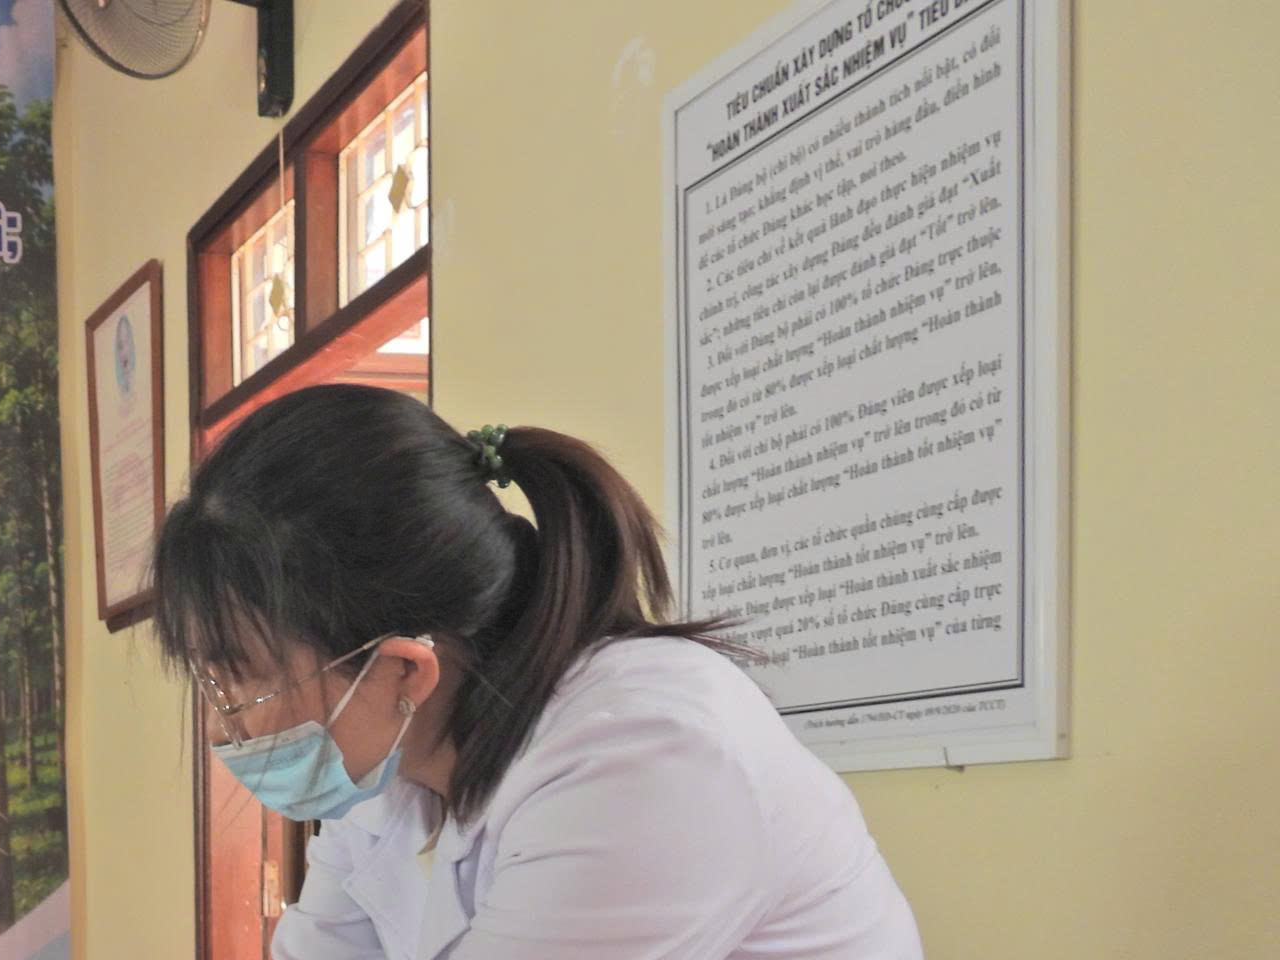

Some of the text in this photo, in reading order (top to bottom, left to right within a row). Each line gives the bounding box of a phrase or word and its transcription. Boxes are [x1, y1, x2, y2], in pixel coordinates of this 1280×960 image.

[725, 90, 748, 120] TIÊU
[752, 63, 789, 103] CHUẨN
[792, 45, 814, 76] XÂY
[818, 19, 853, 59] DỰNG
[856, 4, 872, 33] TỔ
[742, 103, 778, 141] THÀNH
[781, 82, 810, 117] XUẤT
[814, 65, 838, 96] SẮC
[842, 34, 884, 78] NHIỆM
[918, 4, 948, 30] TIÊU
